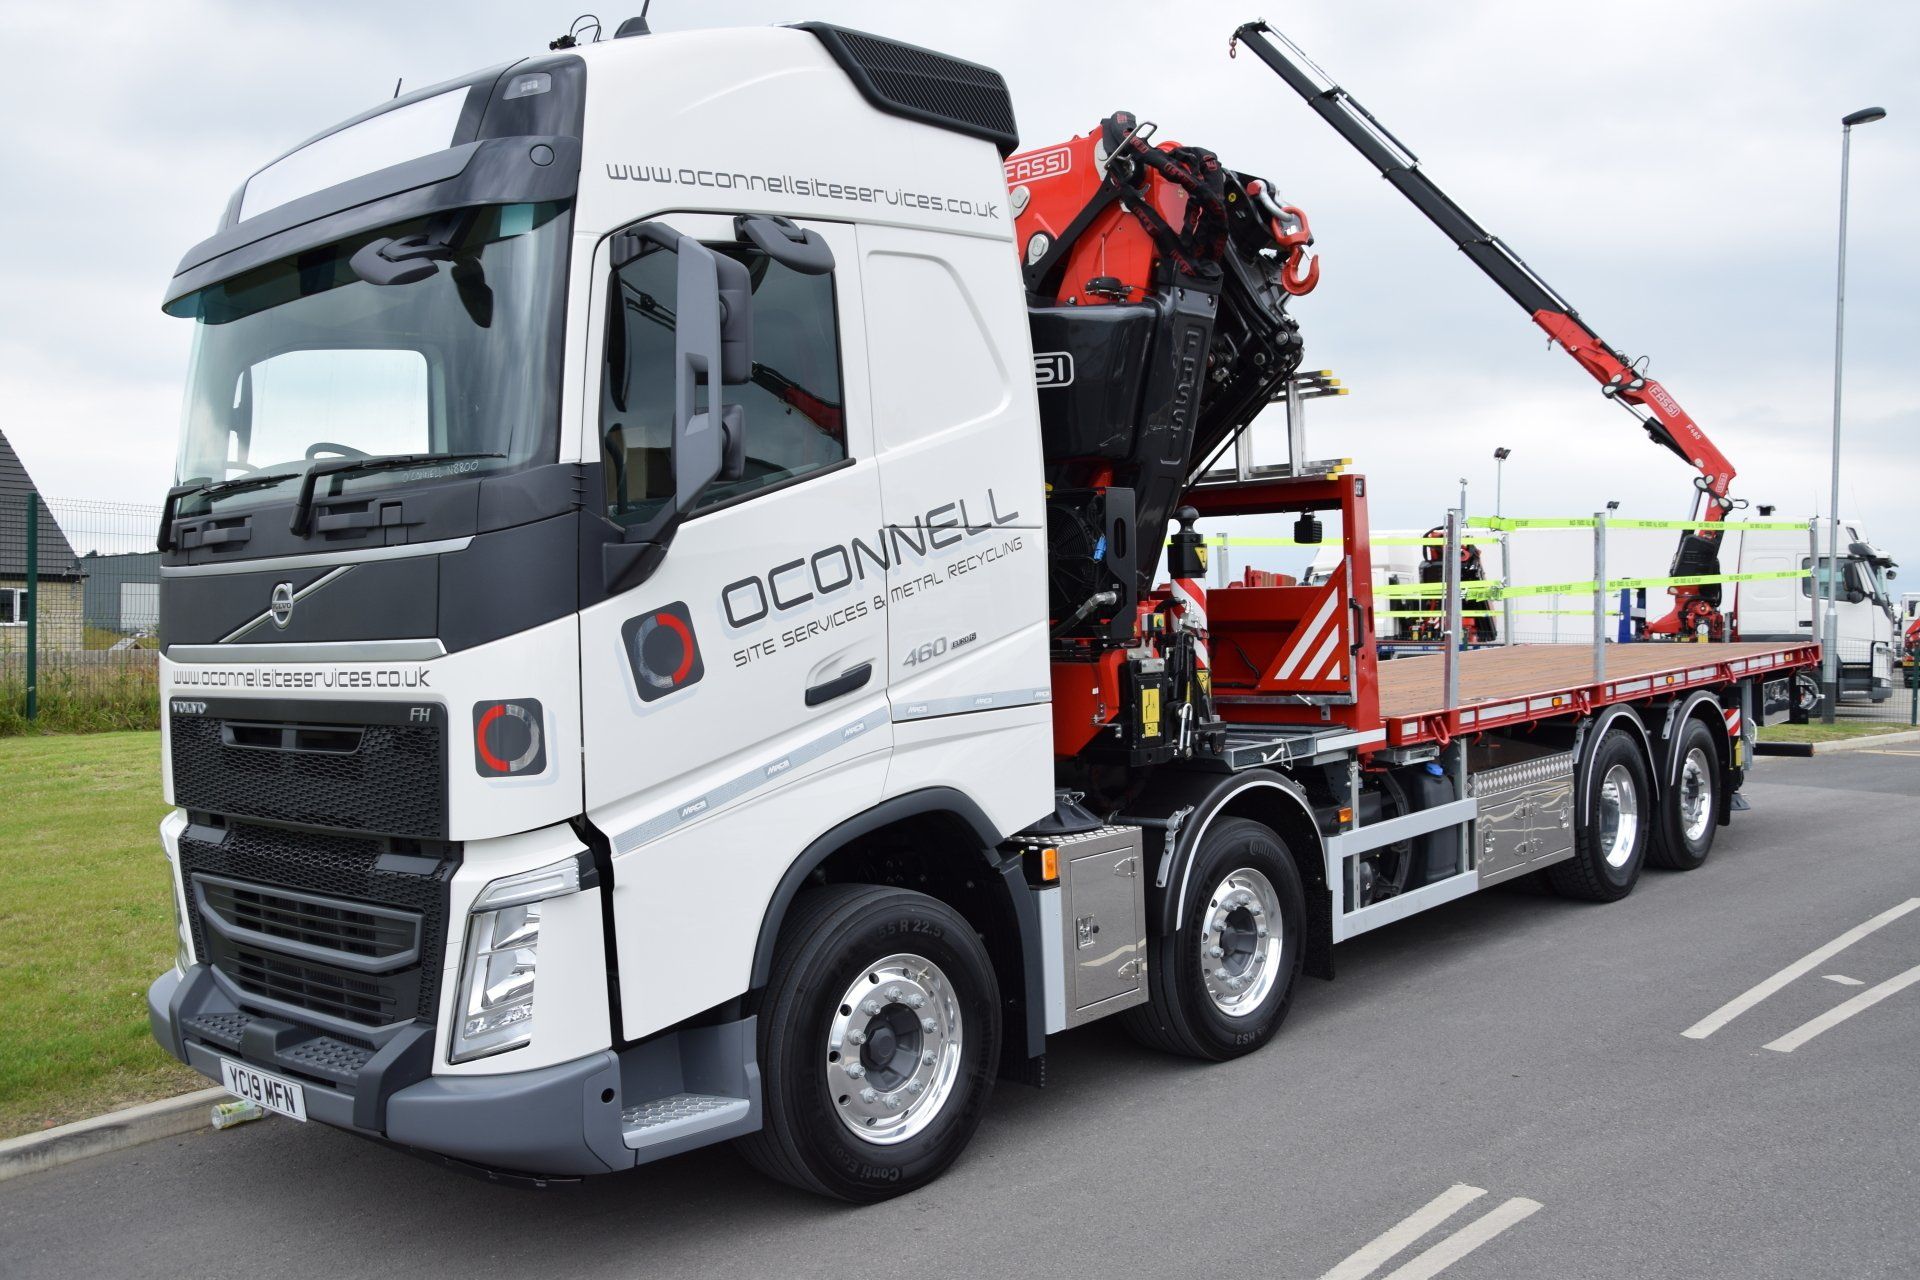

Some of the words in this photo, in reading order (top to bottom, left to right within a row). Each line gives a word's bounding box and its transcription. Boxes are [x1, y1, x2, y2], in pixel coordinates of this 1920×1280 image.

[1004, 153, 1065, 181] FASSI
[605, 162, 1000, 220] www.oconnellsiteservices.co.uk
[1650, 385, 1679, 417] FASSI
[721, 488, 1020, 629] OCONNELL
[733, 638, 777, 668] SITE
[781, 600, 868, 648] SERVICES
[873, 595, 888, 610] &
[890, 572, 944, 603] METAL
[947, 536, 1023, 579] RECYCLING
[902, 636, 948, 667] 460
[172, 666, 431, 688] www.oconnellsiteservices.co.uk
[172, 701, 208, 714] VOLVO
[409, 707, 431, 722] FH
[912, 918, 943, 938] 22.5
[1236, 1031, 1256, 1046] HS3
[229, 1066, 262, 1101] YC19
[263, 1078, 296, 1114] MFN
[860, 1165, 900, 1181] Conti
